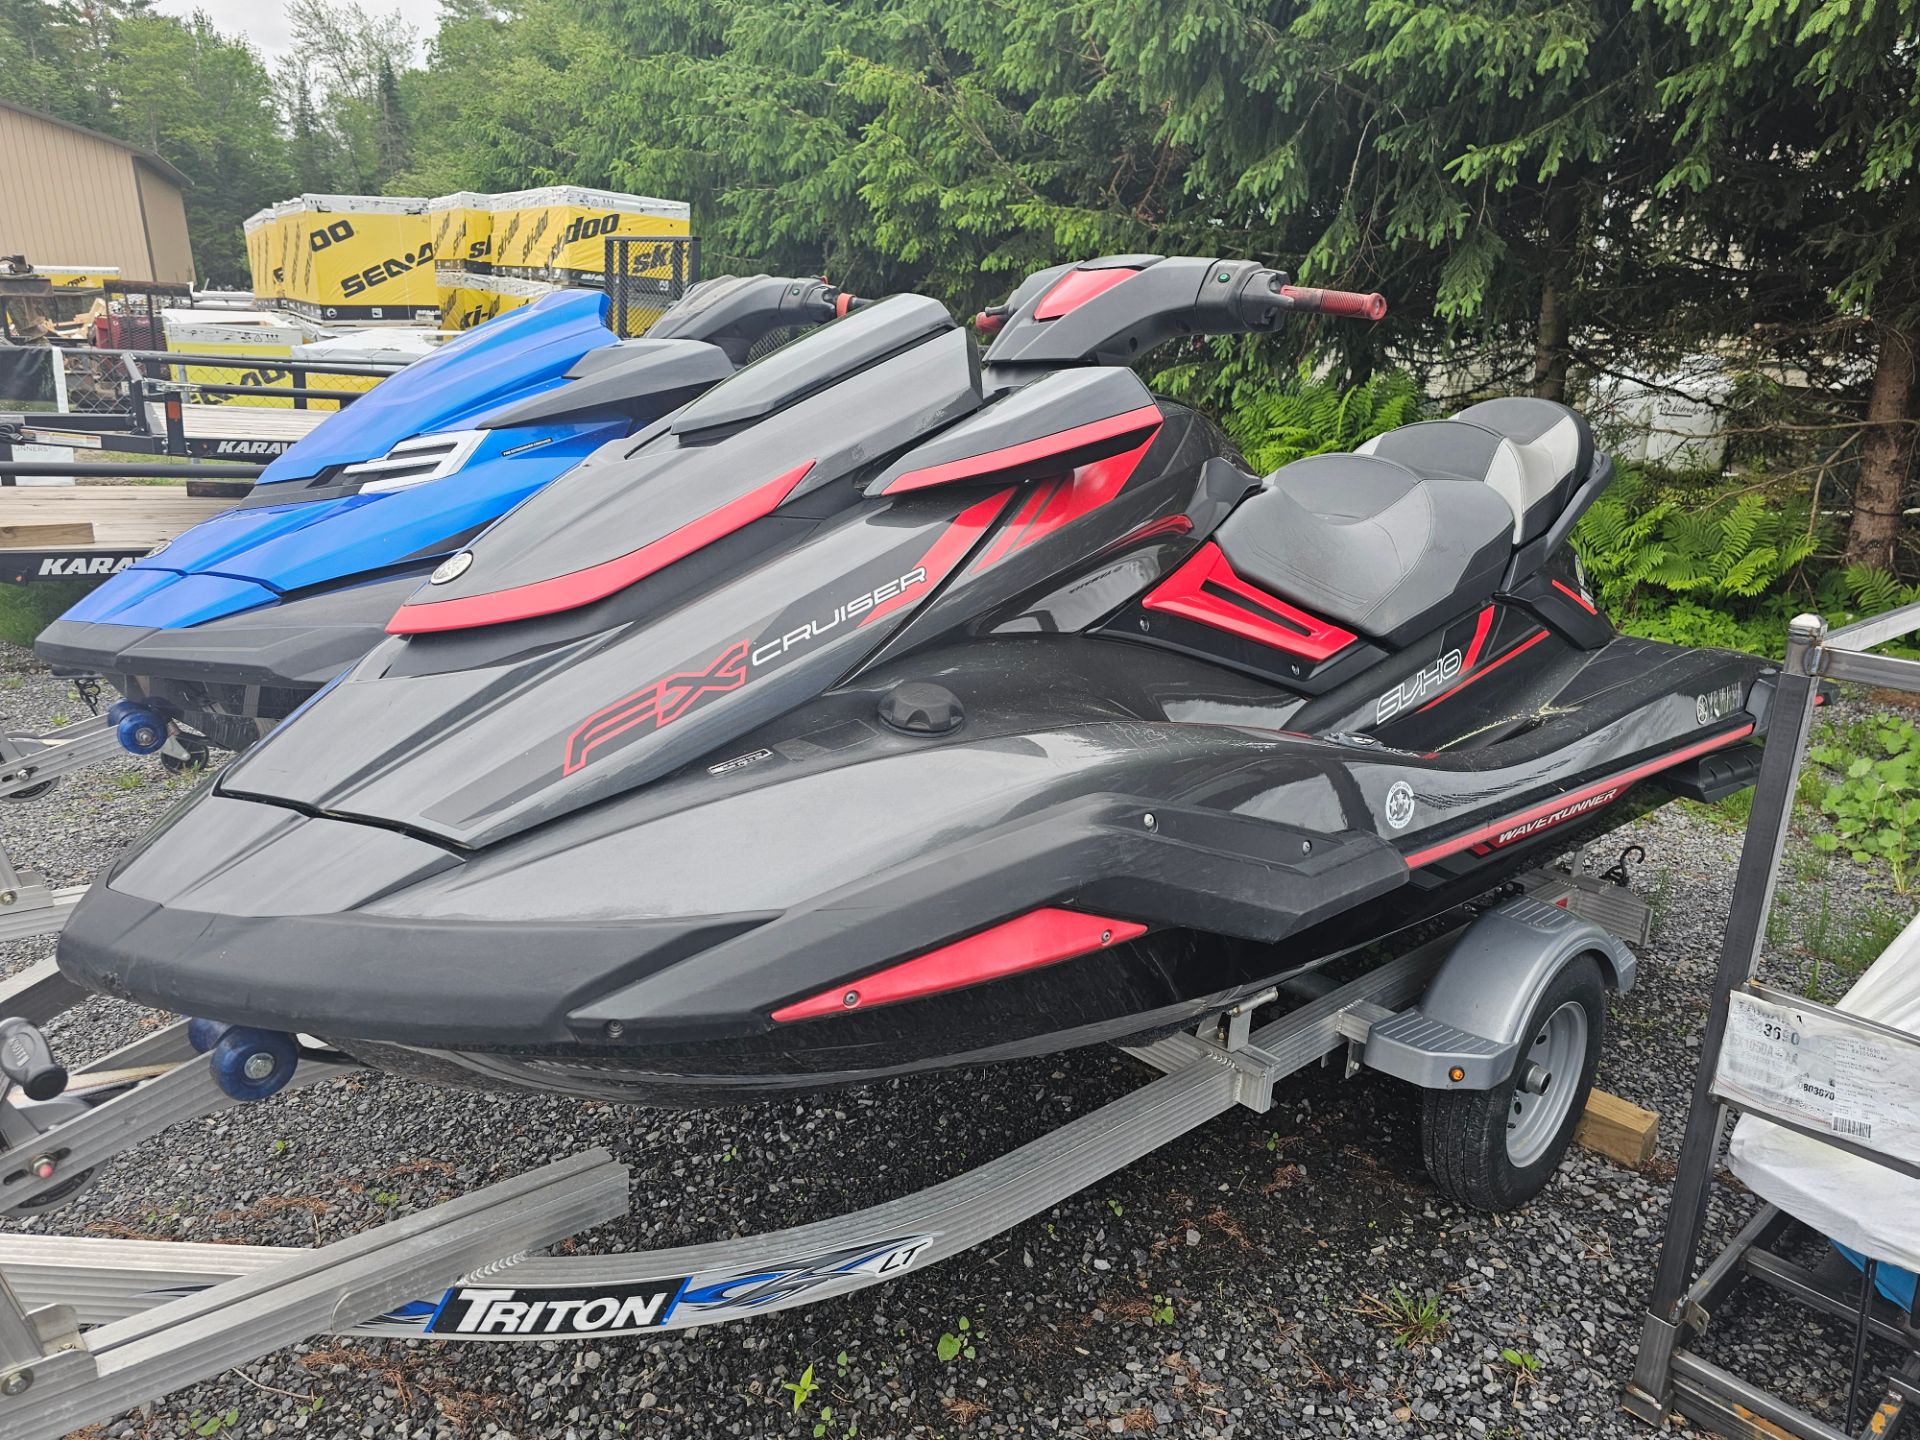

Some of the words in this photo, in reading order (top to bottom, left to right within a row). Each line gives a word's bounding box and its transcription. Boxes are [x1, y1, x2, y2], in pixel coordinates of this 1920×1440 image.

[38, 557, 144, 576] KARA
[563, 639, 749, 777] FX
[751, 566, 927, 667] CRUISER
[1498, 788, 1618, 844] WAVERUNNER
[878, 1241, 929, 1274] LT
[456, 1289, 668, 1333] TRITON
